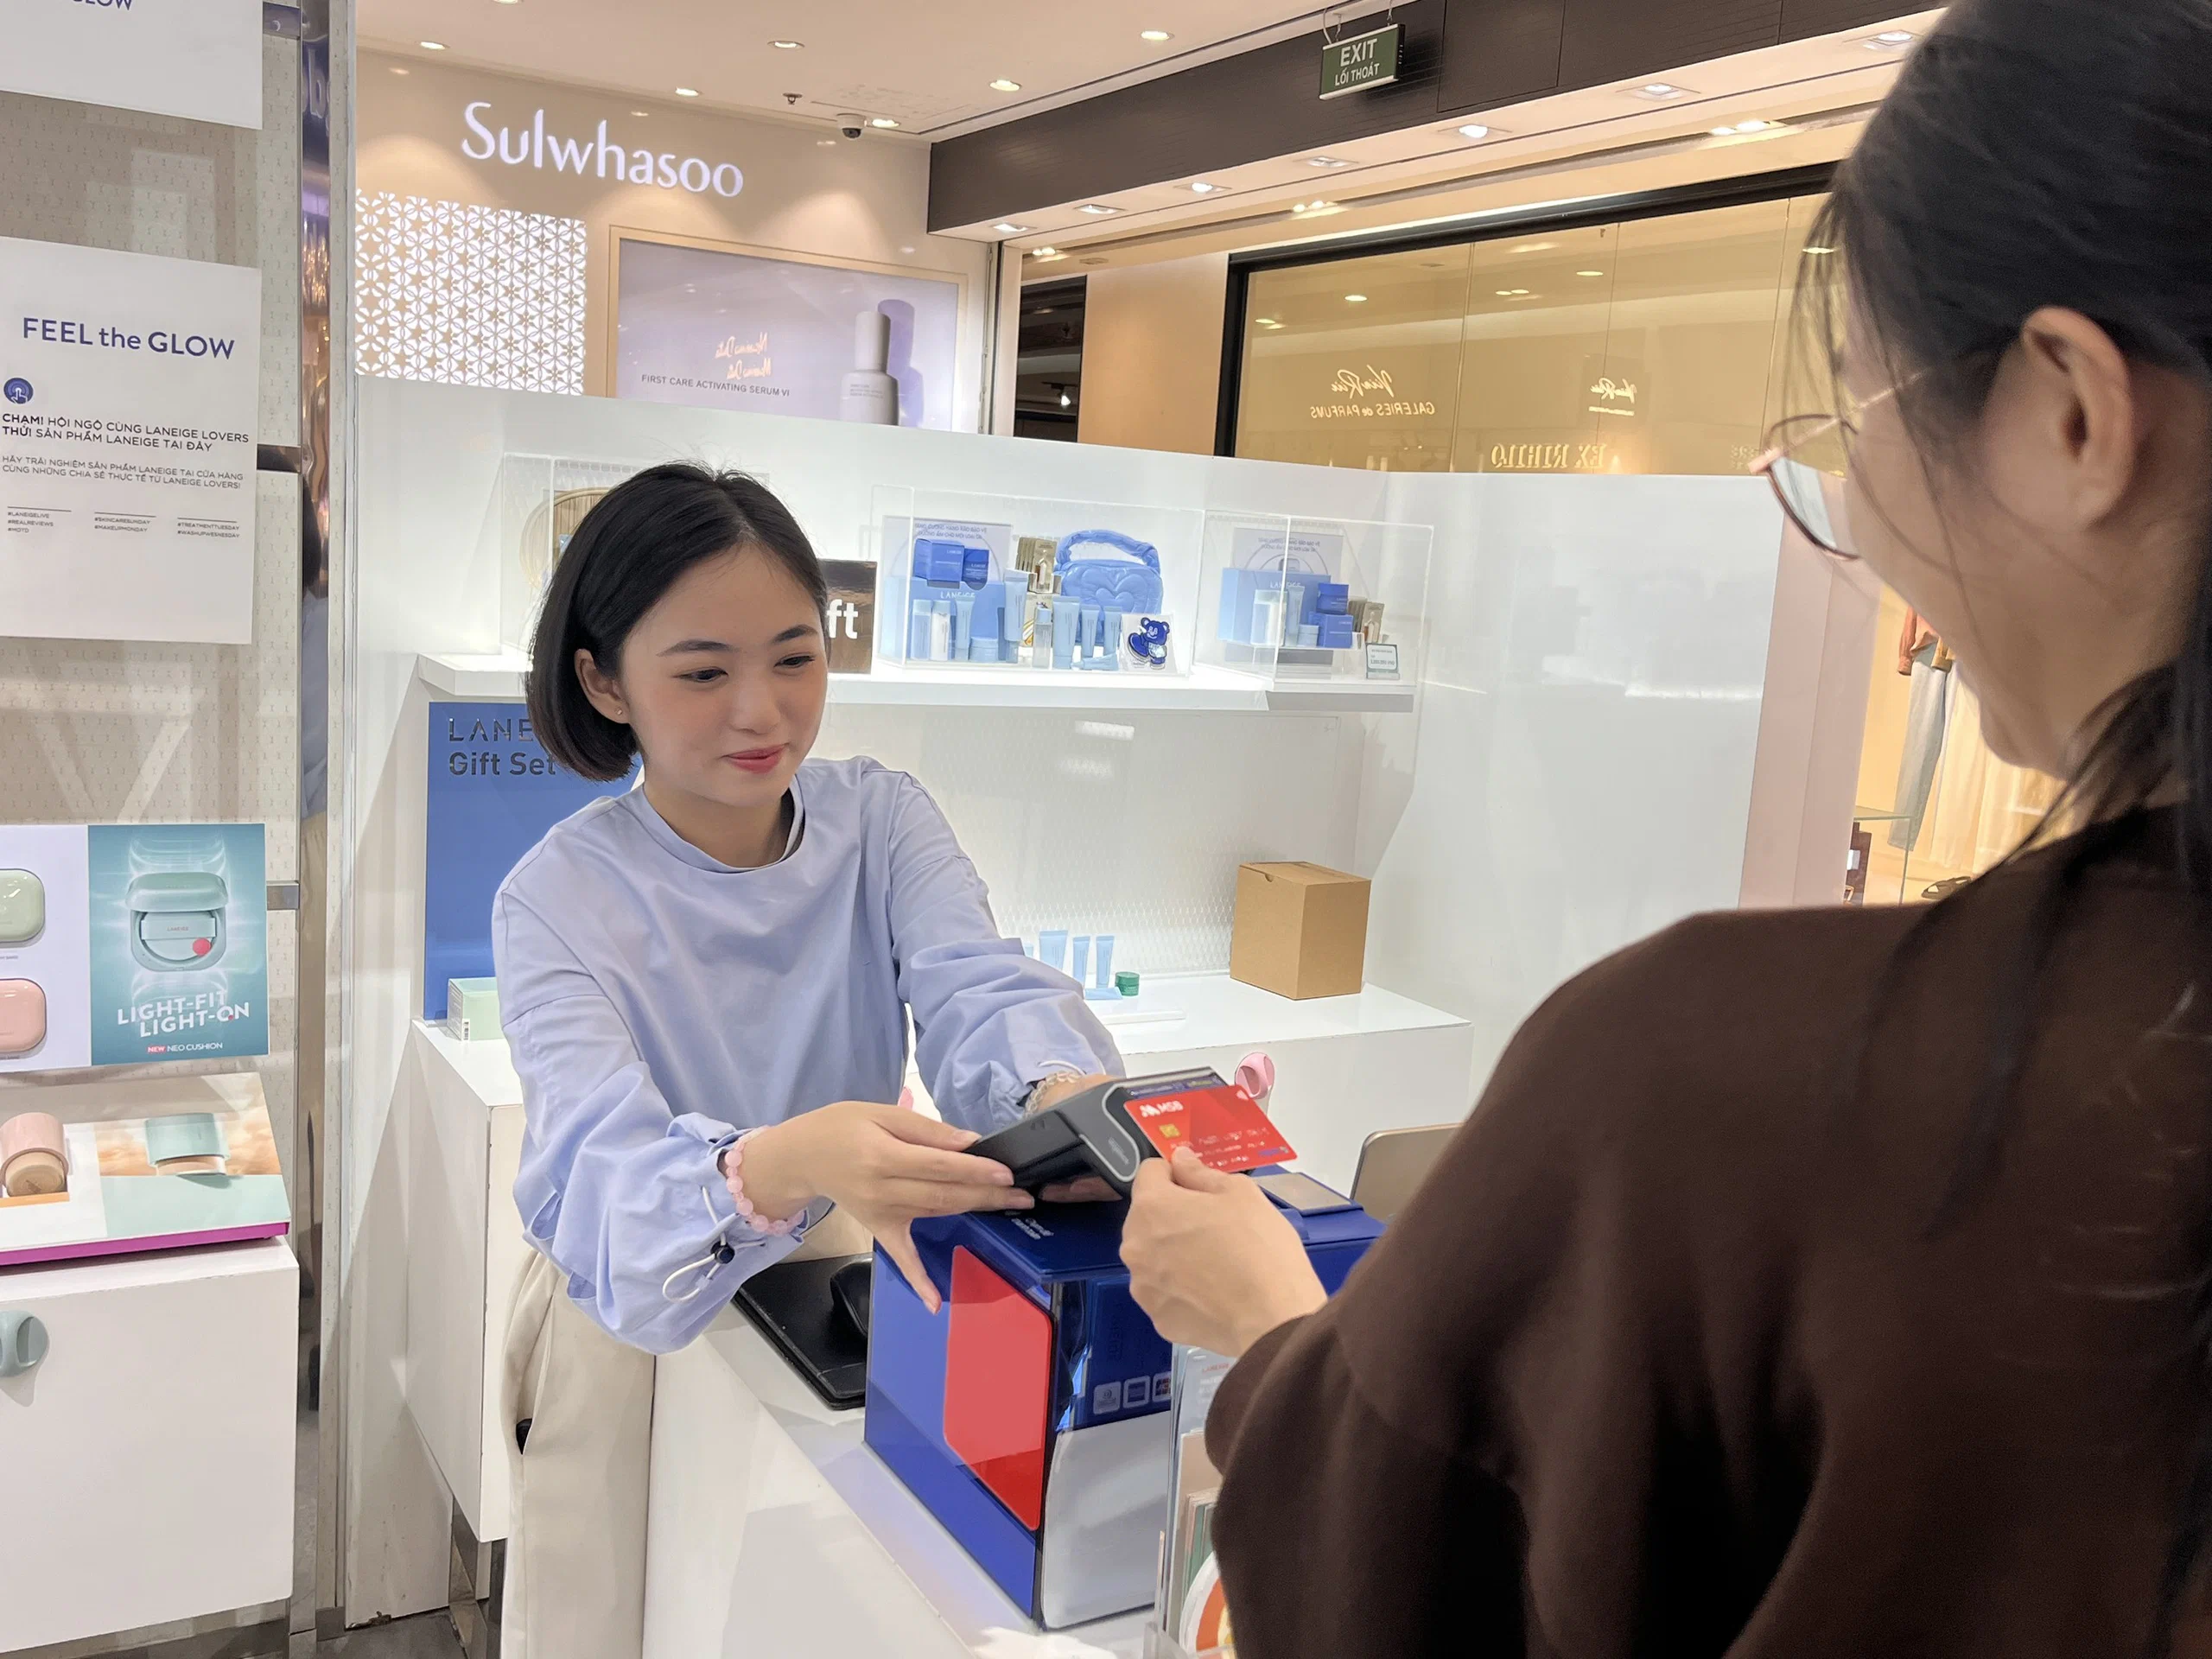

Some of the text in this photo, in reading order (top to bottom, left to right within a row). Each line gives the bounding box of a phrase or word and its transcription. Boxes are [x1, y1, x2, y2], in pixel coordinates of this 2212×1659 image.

[1340, 38, 1378, 67] EXIT
[1334, 61, 1380, 86] LỐI THOÁT
[461, 101, 744, 197] Sulwhasoo
[23, 317, 235, 359] FEEL the GLOW
[641, 374, 667, 385] FIRST
[670, 377, 693, 387] CARE
[696, 380, 747, 392] ACTIVATING
[749, 385, 779, 396] SERUM
[48, 416, 70, 428] HỘI
[74, 419, 102, 431] NGỘ
[145, 425, 199, 438] LANEIGE
[202, 430, 249, 442] LOVERS
[106, 435, 159, 448] LANEIGE
[139, 466, 177, 475] LANEIGE
[163, 476, 201, 486] LANEIGE
[826, 599, 859, 639] ft
[448, 718, 534, 741] LANE
[448, 752, 556, 776] Gift Set
[118, 991, 227, 1025] LIGHT-FIT
[140, 1001, 250, 1037] LIGHT-ON
[186, 1042, 223, 1051] CUSHION
